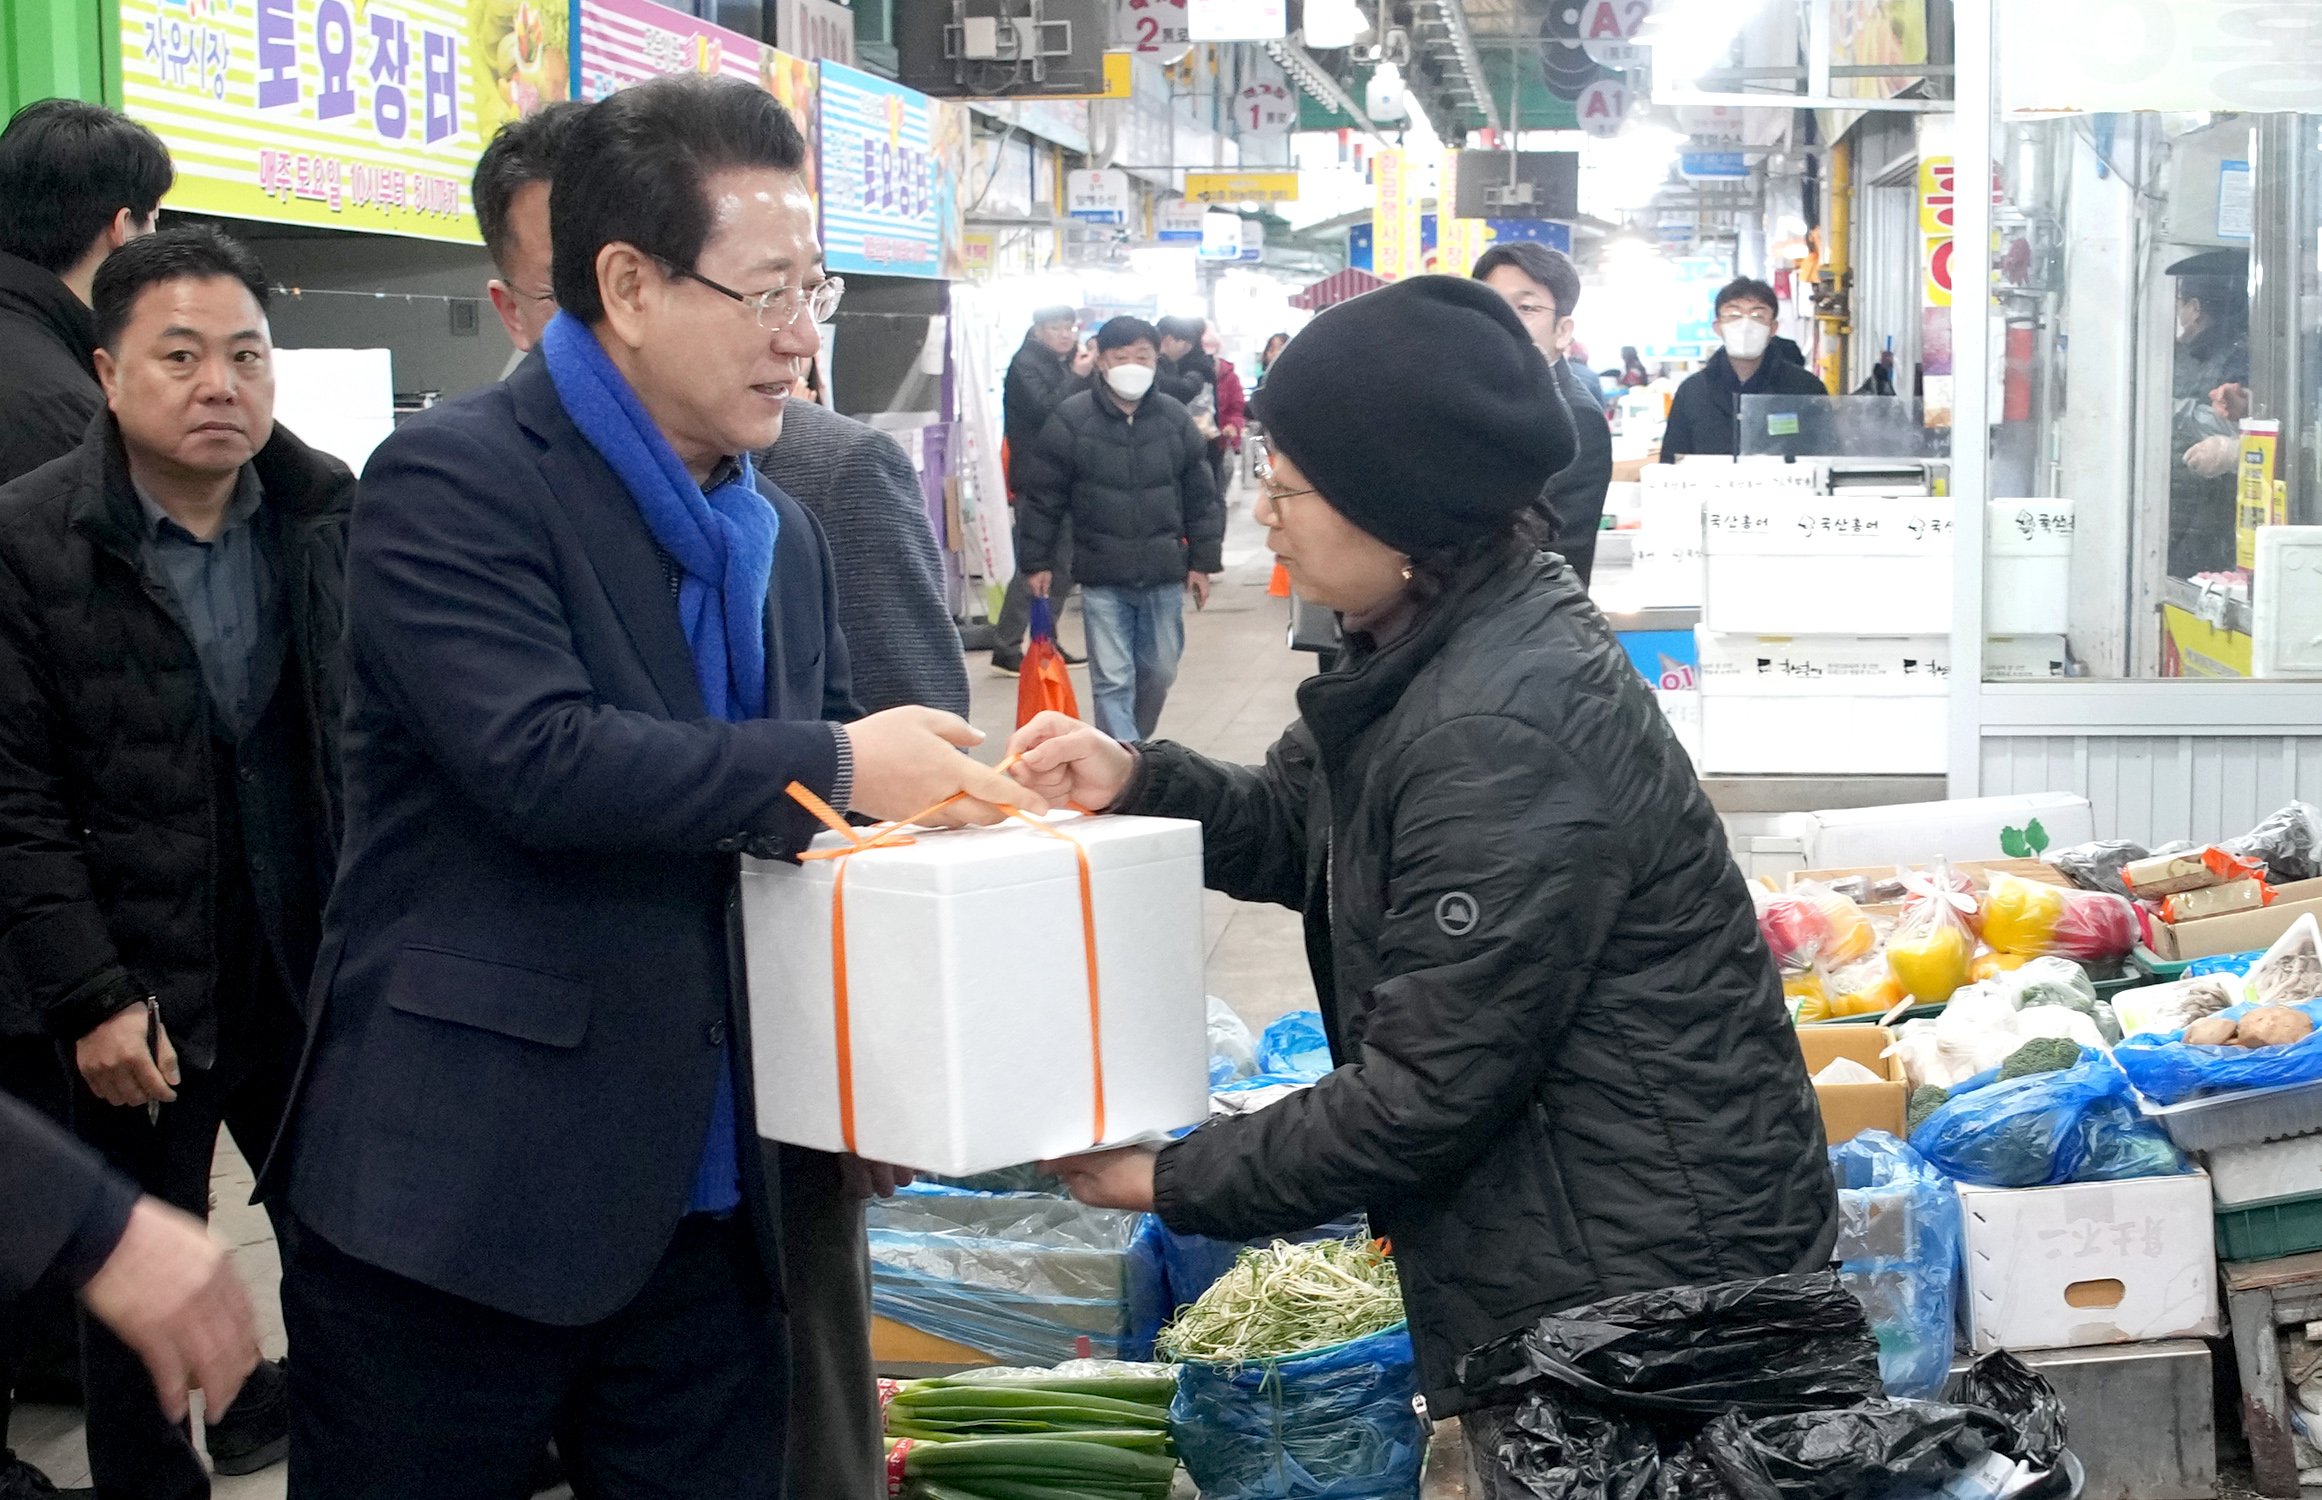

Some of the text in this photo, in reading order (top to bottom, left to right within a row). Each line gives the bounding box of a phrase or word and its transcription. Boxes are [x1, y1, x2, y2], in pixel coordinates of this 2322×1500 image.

[1136, 17, 1159, 52] 2
[1589, 0, 1649, 38] A2
[145, 16, 230, 100] 자유시장
[257, 0, 459, 144] 토요장터
[1250, 104, 1260, 130] 1
[1585, 90, 1623, 119] A1
[260, 150, 292, 202] 매주
[295, 155, 341, 210] 토요일
[351, 162, 406, 213] 10시부터
[863, 138, 929, 216] 토요장터
[1710, 514, 1768, 530] 국산홍어
[1820, 517, 1878, 533] 국산홍어
